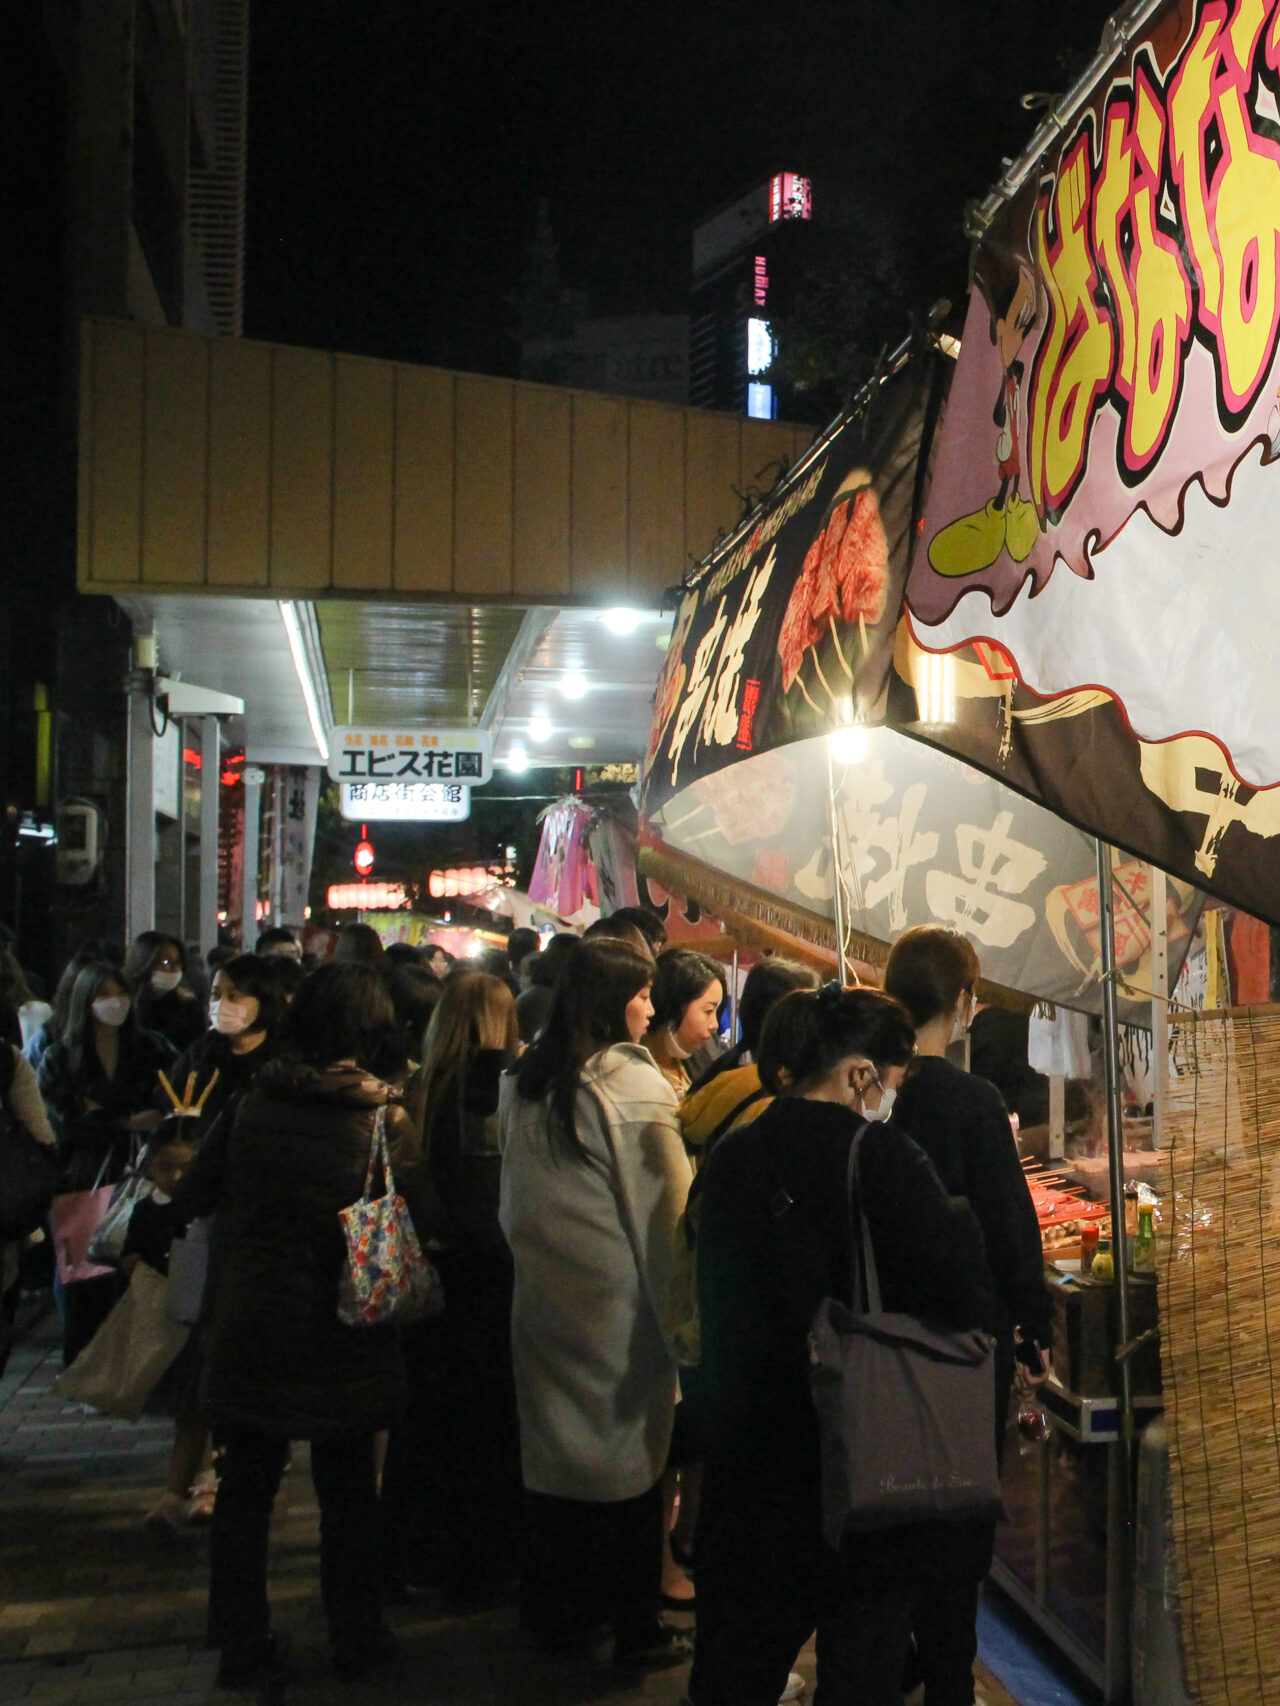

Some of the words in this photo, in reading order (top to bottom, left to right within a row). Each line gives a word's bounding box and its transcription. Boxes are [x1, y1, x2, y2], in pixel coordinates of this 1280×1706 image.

[755, 256, 768, 306] HUMAX
[339, 750, 483, 778] エビス花園
[349, 783, 462, 802] 商店街会館
